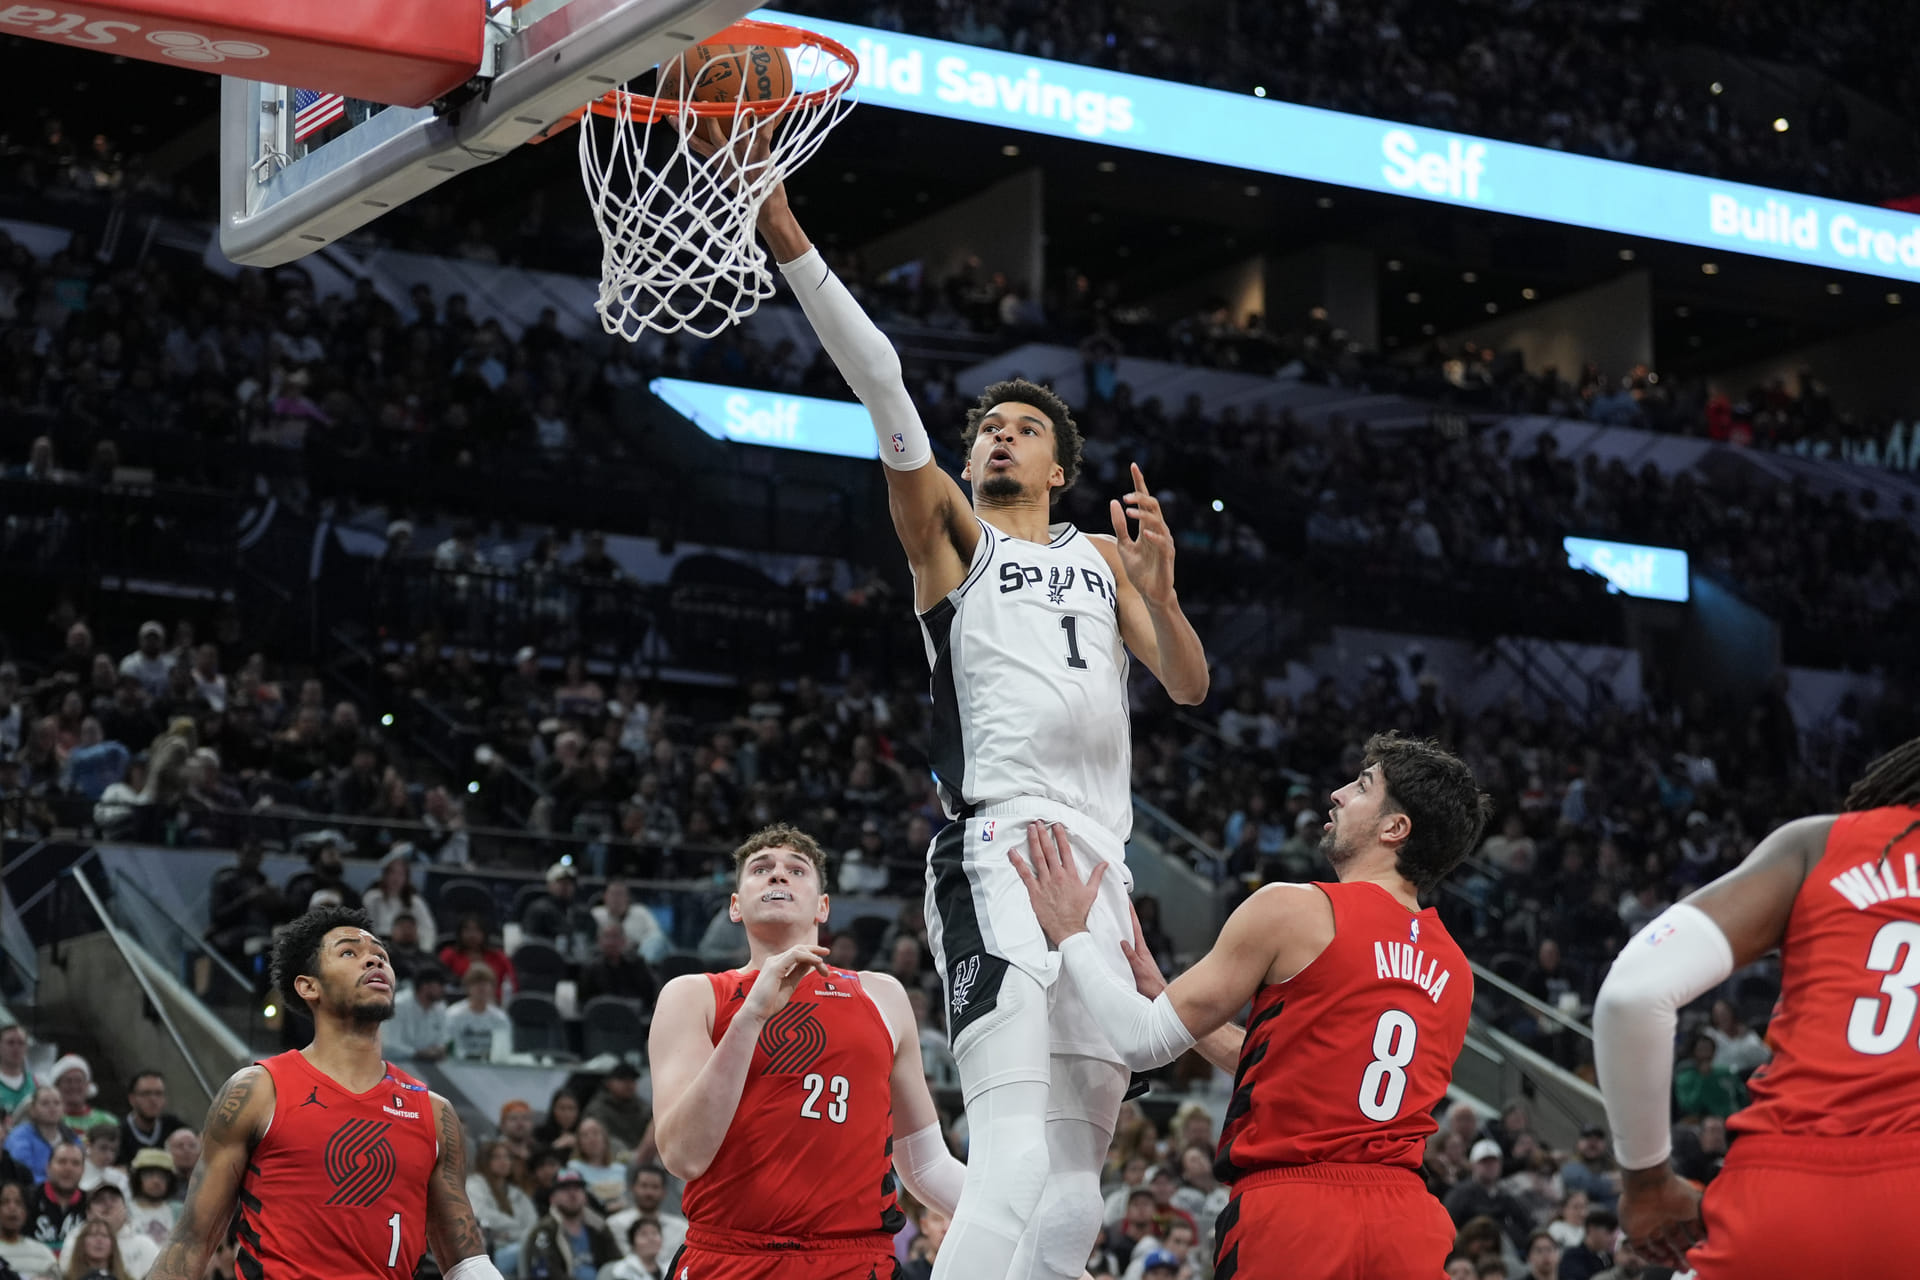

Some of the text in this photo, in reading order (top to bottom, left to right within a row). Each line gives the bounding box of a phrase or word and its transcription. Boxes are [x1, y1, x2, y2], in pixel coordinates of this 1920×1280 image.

[938, 57, 1134, 136] Savings
[1383, 129, 1486, 199] Self
[1709, 193, 1920, 267] Build Cred
[725, 395, 800, 440] Self
[1060, 614, 1089, 671] 1
[1374, 941, 1450, 1004] AVDIJA
[1847, 920, 1920, 1055] 3
[1358, 1009, 1418, 1122] 8
[382, 1104, 420, 1119] BRIGHTSIDE
[800, 1072, 850, 1124] 23
[387, 1212, 401, 1268] 1
